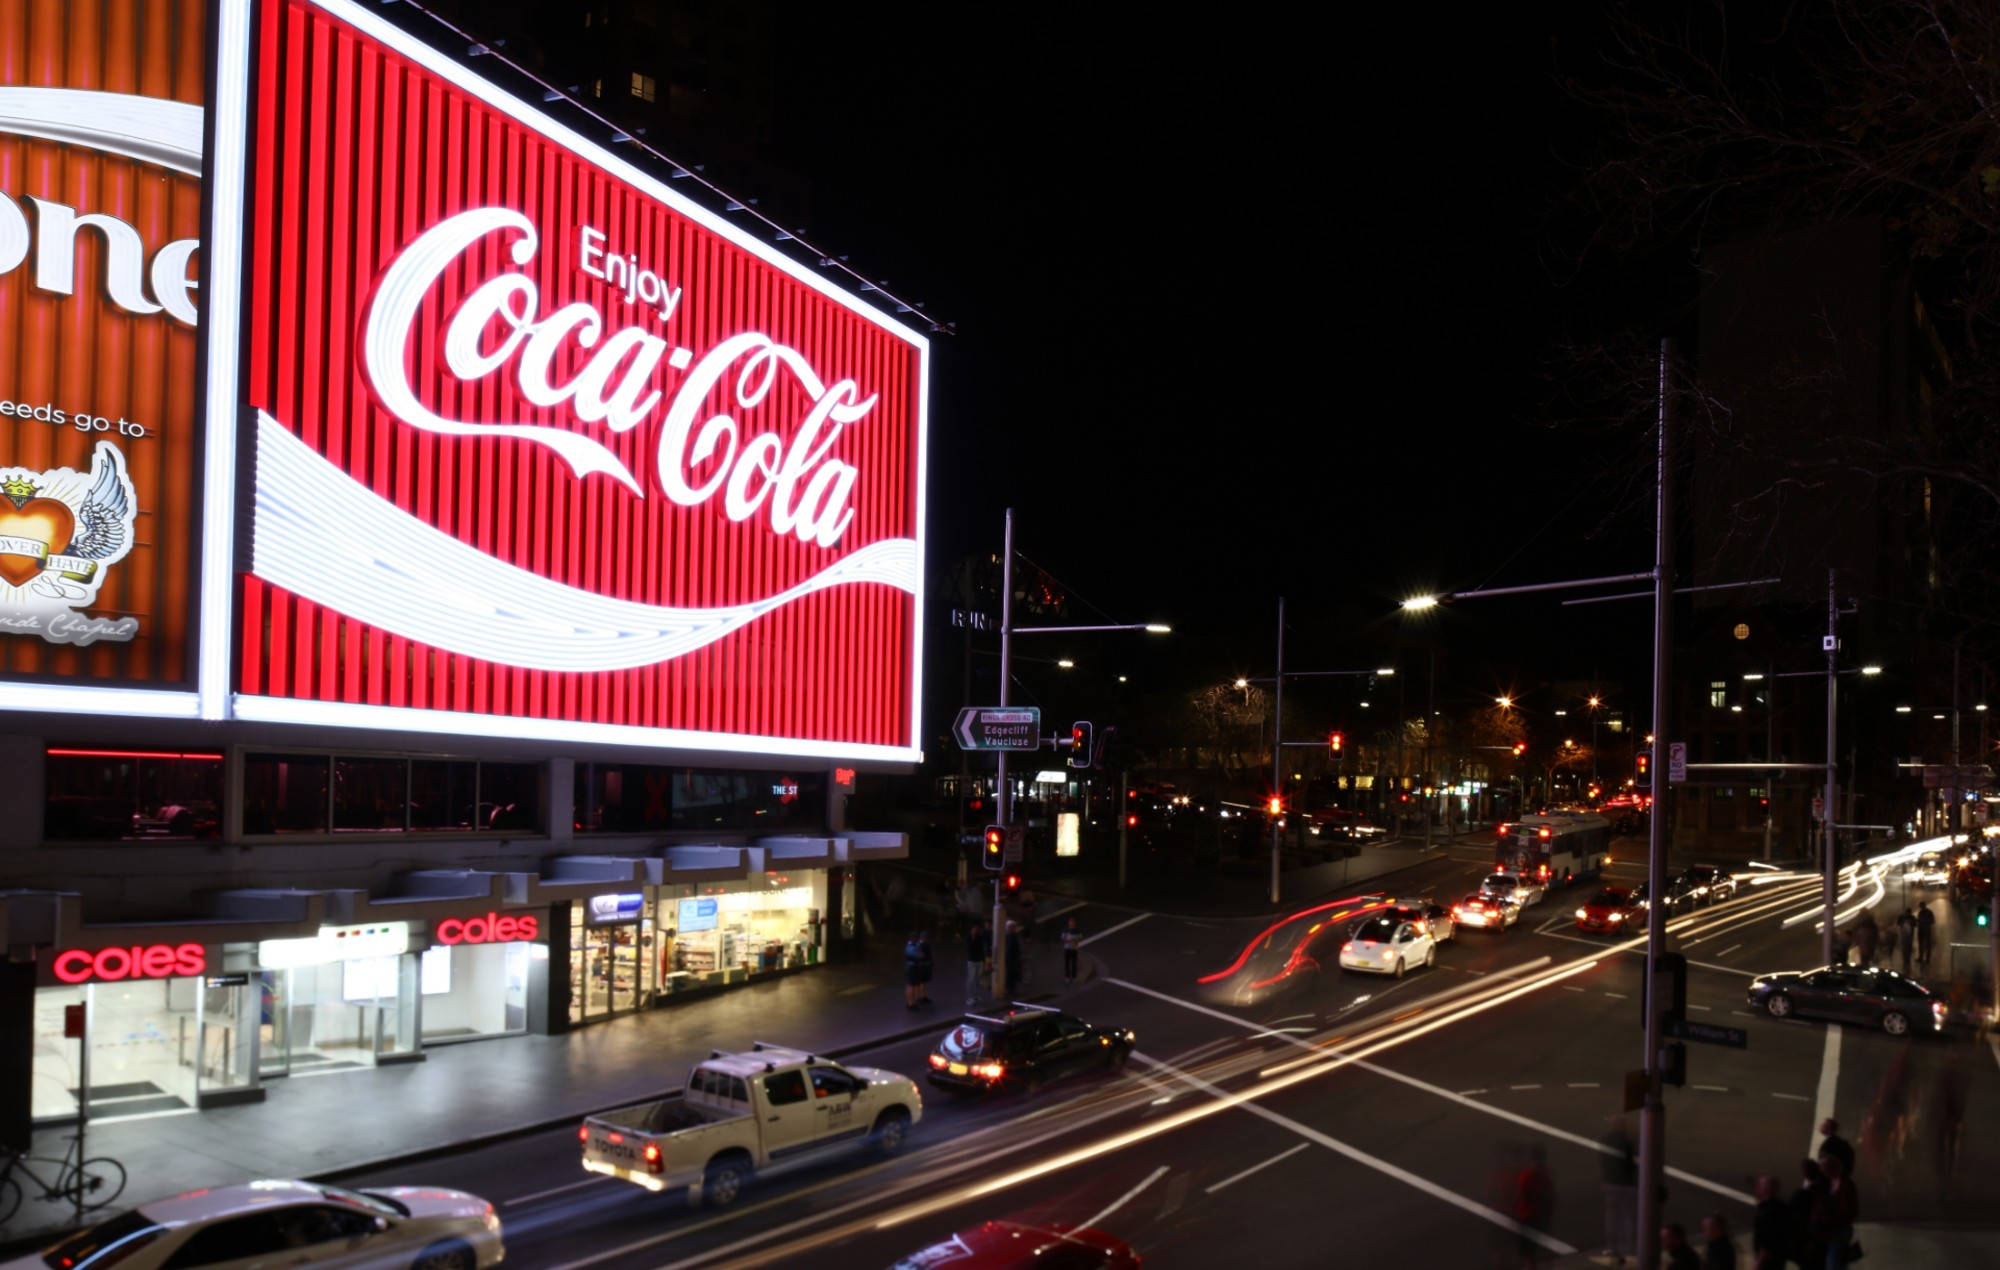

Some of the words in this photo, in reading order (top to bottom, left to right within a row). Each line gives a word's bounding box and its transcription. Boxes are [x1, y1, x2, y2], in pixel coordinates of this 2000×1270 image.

[580, 226, 682, 320] Enjoy
[365, 206, 879, 548] Coca-Cola
[74, 412, 110, 432] go
[118, 417, 146, 438] to
[48, 554, 94, 575] HATE
[47, 613, 131, 641] Chapel
[984, 725, 1029, 738] Edgecliff
[984, 736, 1029, 746] Vaucluse
[772, 785, 787, 795] THE
[437, 912, 538, 946] coles
[54, 942, 206, 984] coles
[594, 1138, 635, 1160] TOYOTA
